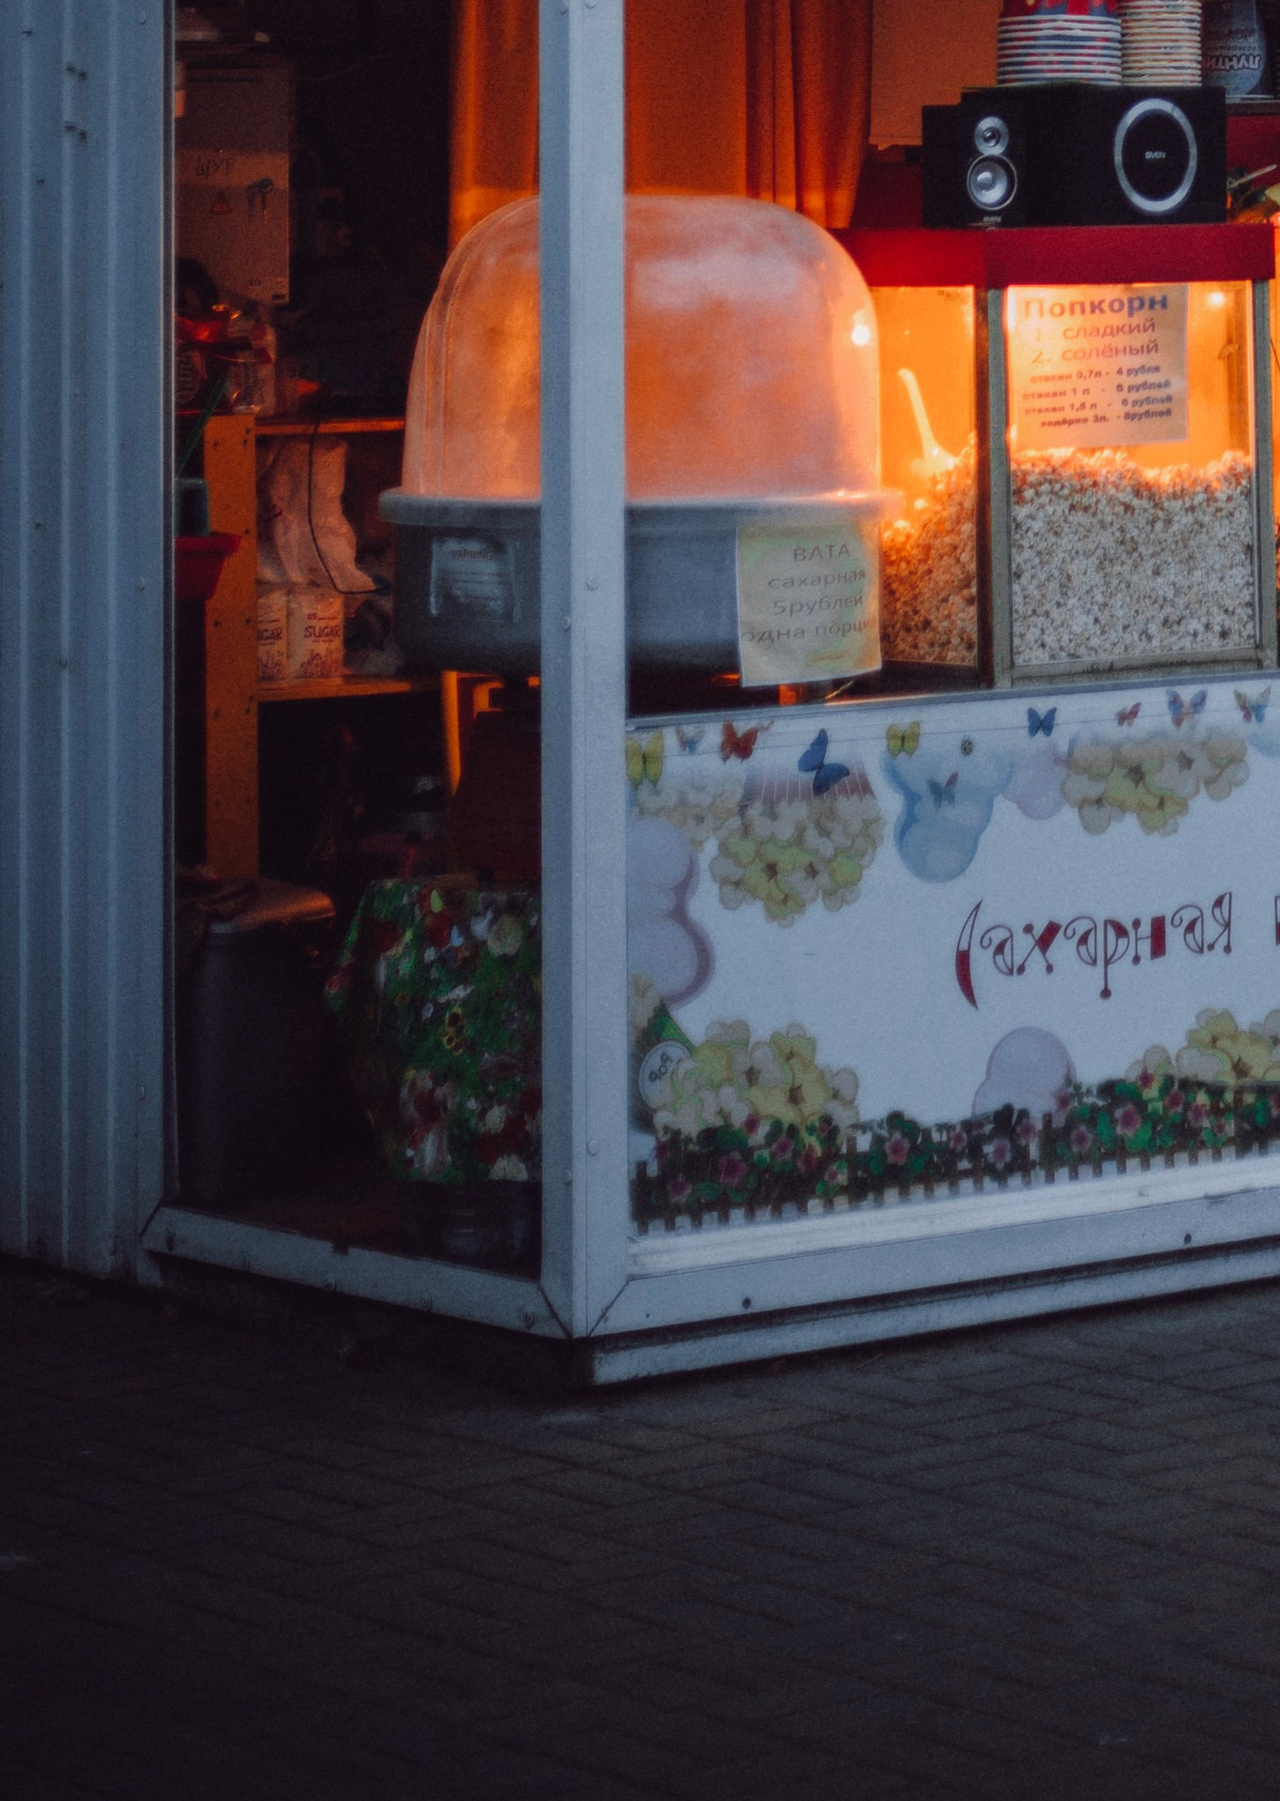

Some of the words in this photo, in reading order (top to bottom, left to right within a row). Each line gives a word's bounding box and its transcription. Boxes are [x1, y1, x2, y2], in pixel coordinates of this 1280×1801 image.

[1203, 54, 1262, 71] ЛУНТИ
[1025, 295, 1167, 318] Попкорн
[1063, 318, 1155, 339] сладкий
[1061, 339, 1158, 361] солёный
[1031, 373, 1072, 383] стакан
[1116, 367, 1123, 376] 4
[1127, 365, 1161, 377] рубля
[1023, 391, 1067, 400] стакан
[1127, 380, 1171, 393] рублей
[1025, 406, 1065, 415] стакан
[1132, 395, 1173, 407] рублей
[793, 543, 850, 562] ВАТА
[768, 570, 866, 589] сахарная
[304, 624, 341, 638] SUGAR
[741, 629, 805, 644] одна
